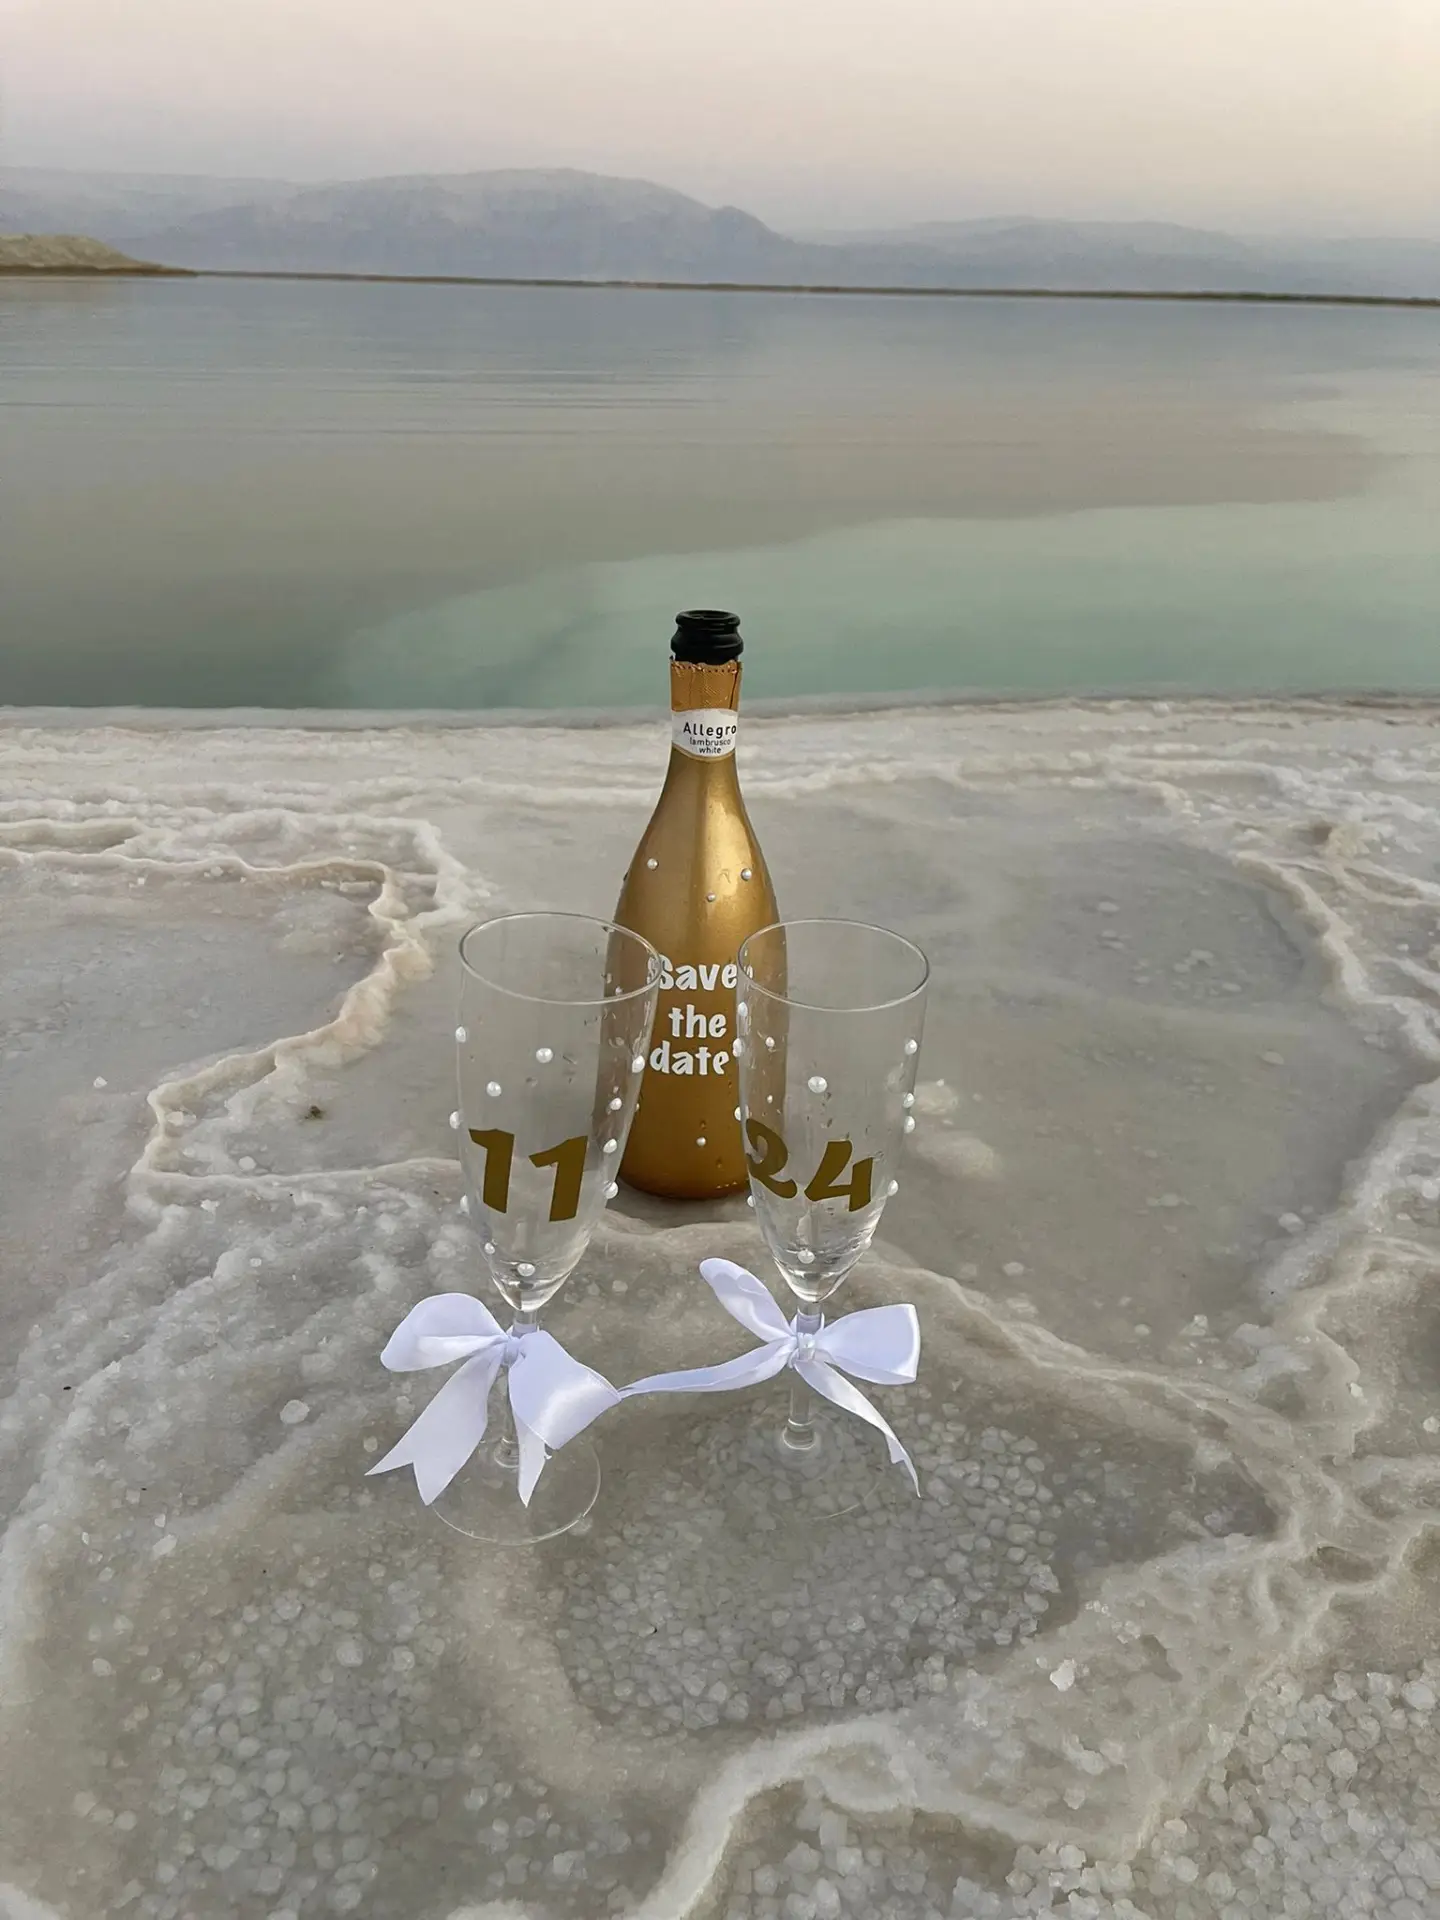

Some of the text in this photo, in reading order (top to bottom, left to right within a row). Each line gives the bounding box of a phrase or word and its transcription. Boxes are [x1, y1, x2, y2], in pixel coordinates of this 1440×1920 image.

[684, 722, 736, 738] Allegro
[699, 746, 722, 754] white
[668, 1004, 727, 1038] the
[650, 1040, 730, 1075] date
[469, 1128, 588, 1222] 11
[746, 1118, 874, 1212] 24
